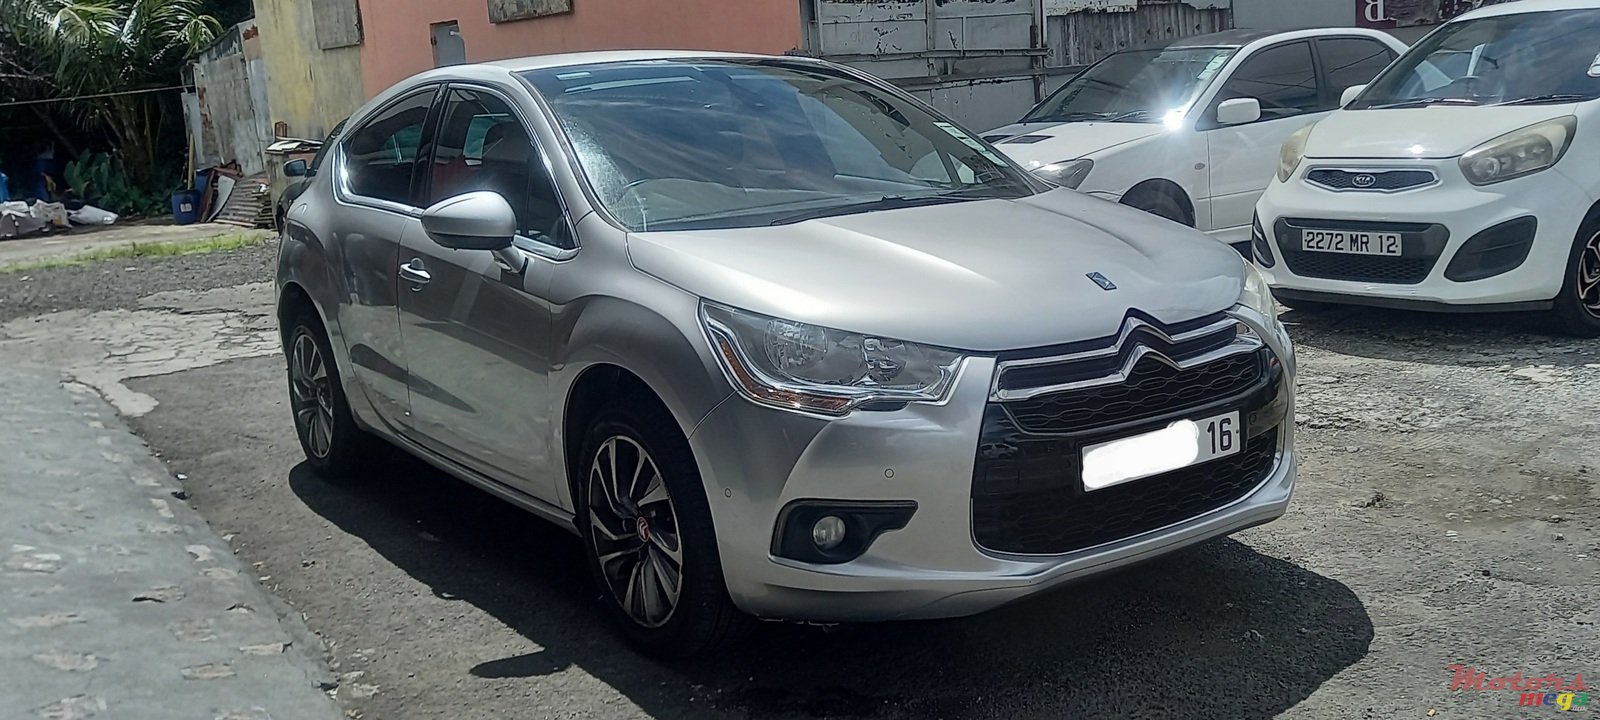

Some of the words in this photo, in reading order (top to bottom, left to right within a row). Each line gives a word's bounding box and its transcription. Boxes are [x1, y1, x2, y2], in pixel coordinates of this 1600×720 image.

[1306, 231, 1344, 251] 2272
[1349, 233, 1370, 253] MR
[1378, 235, 1397, 254] 12
[1207, 418, 1232, 454] 16
